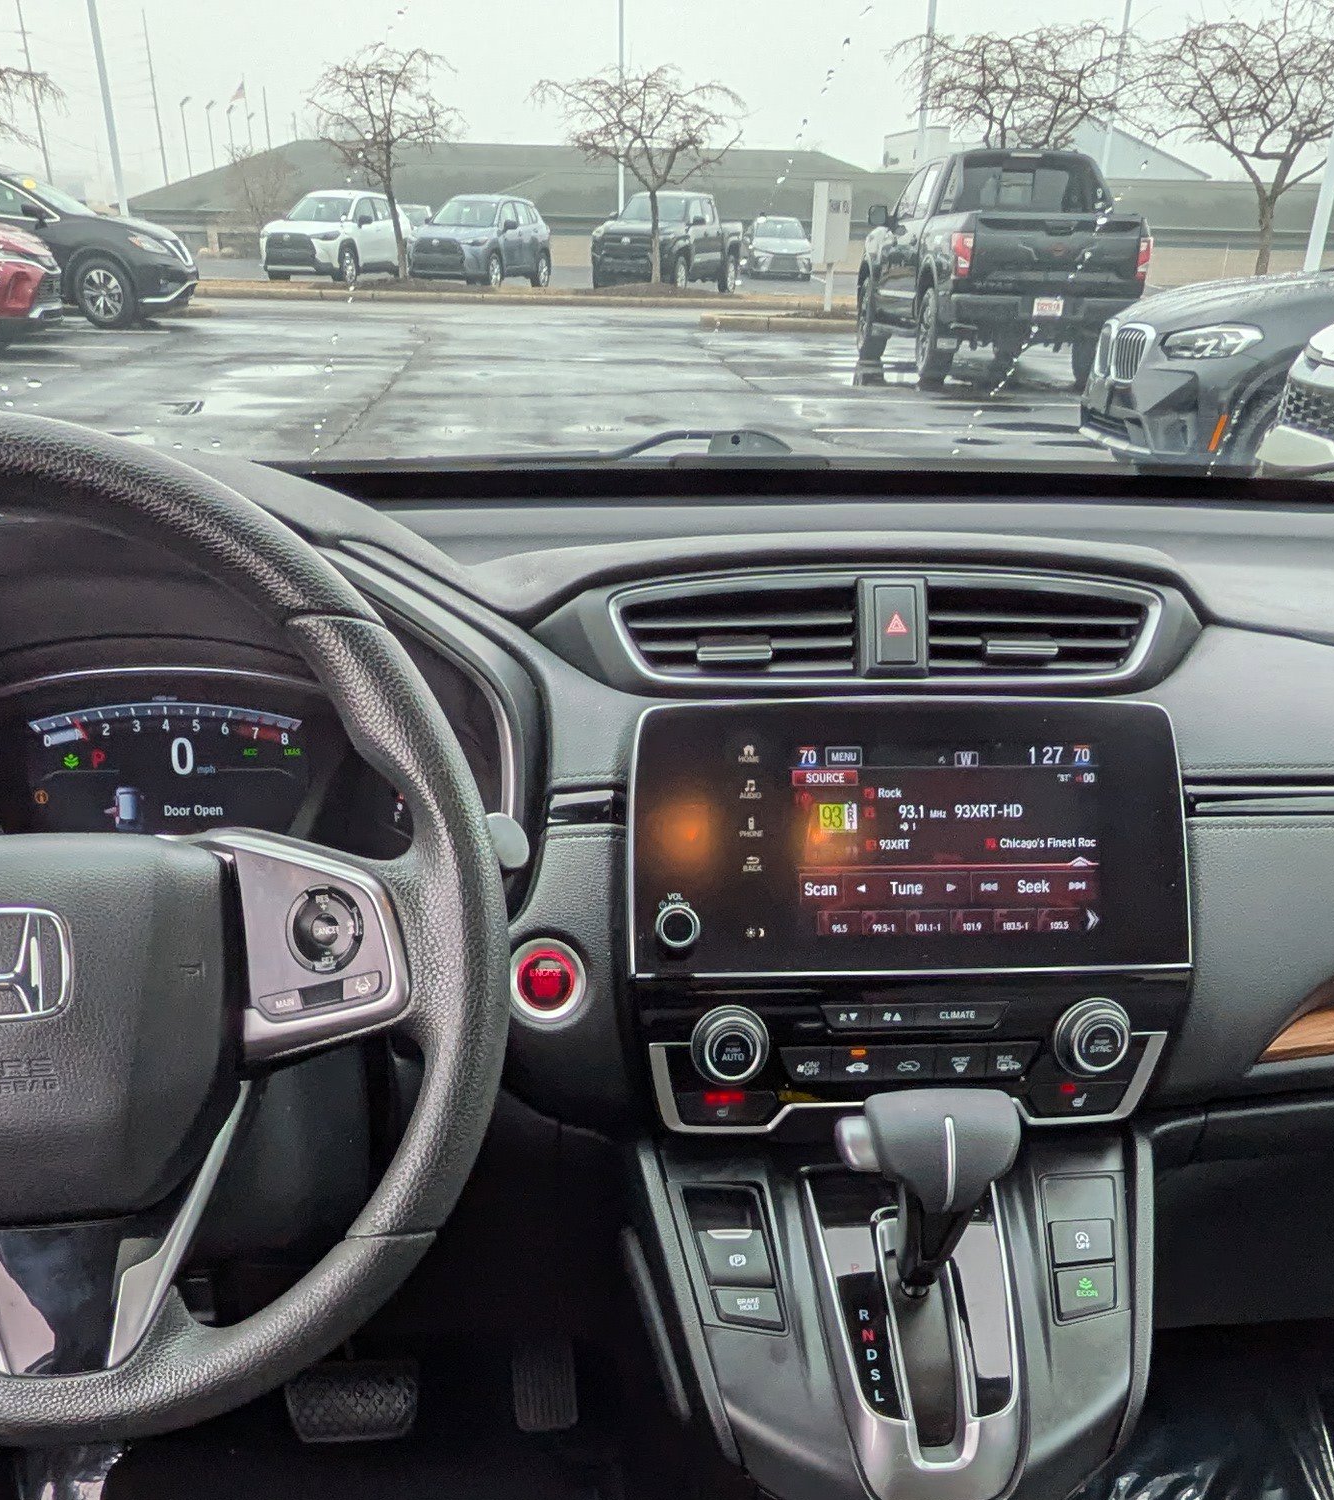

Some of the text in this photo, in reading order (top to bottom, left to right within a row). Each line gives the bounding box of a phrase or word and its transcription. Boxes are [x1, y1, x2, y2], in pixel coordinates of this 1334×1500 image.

[170, 736, 194, 775] 0
[799, 749, 817, 764] 70
[830, 751, 857, 763] MENU
[805, 772, 845, 784] SOURCE
[739, 791, 762, 800] AUDIO
[877, 787, 903, 799] Rock
[163, 804, 224, 818] Door Open
[898, 804, 925, 819] 93.1
[954, 803, 1023, 818] 93XRT-HD
[739, 829, 764, 838] PHONE
[879, 838, 911, 850] 93XRT
[999, 837, 1097, 850] Chicago's Finest Roc
[742, 864, 763, 873] BACK
[804, 881, 838, 897] Scan
[889, 880, 924, 896] Tune
[1017, 878, 1051, 894] Seek
[667, 892, 684, 901] VOL
[275, 998, 295, 1009] MAIN
[939, 1010, 976, 1020] CLIMATE
[721, 1053, 745, 1062] AUTO
[1075, 1289, 1099, 1297] ECON
[736, 1296, 760, 1305] BRAKE
[739, 1303, 760, 1311] HOLD
[858, 1309, 870, 1321] R
[861, 1329, 876, 1342] N
[866, 1348, 878, 1361] D
[870, 1368, 881, 1381] S
[875, 1390, 885, 1402] L
